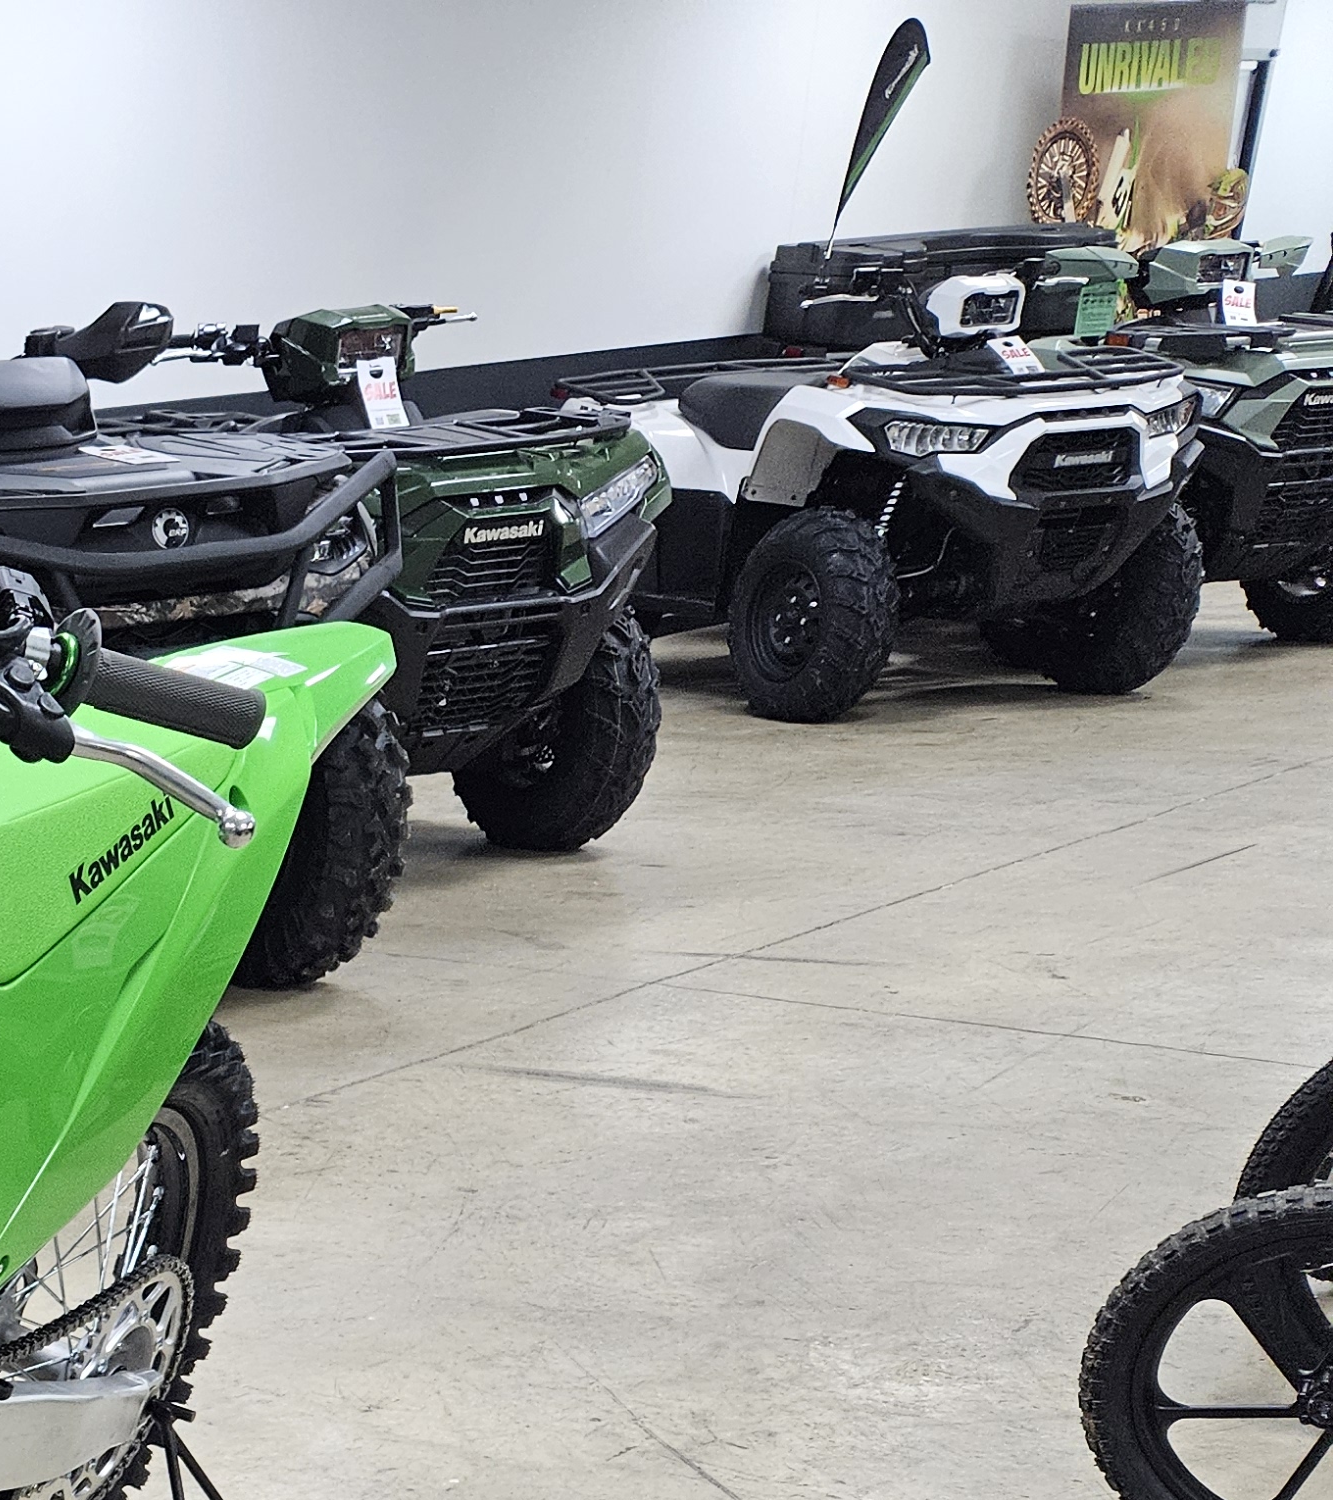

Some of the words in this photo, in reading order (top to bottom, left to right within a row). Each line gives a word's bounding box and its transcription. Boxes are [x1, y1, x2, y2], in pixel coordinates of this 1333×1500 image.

[1224, 295, 1252, 308] SALE
[1001, 347, 1031, 359] SALE
[364, 381, 397, 401] SALE
[1053, 450, 1114, 468] Kawasaki
[463, 519, 545, 544] Kawasaki
[68, 790, 175, 906] Kawasaki
